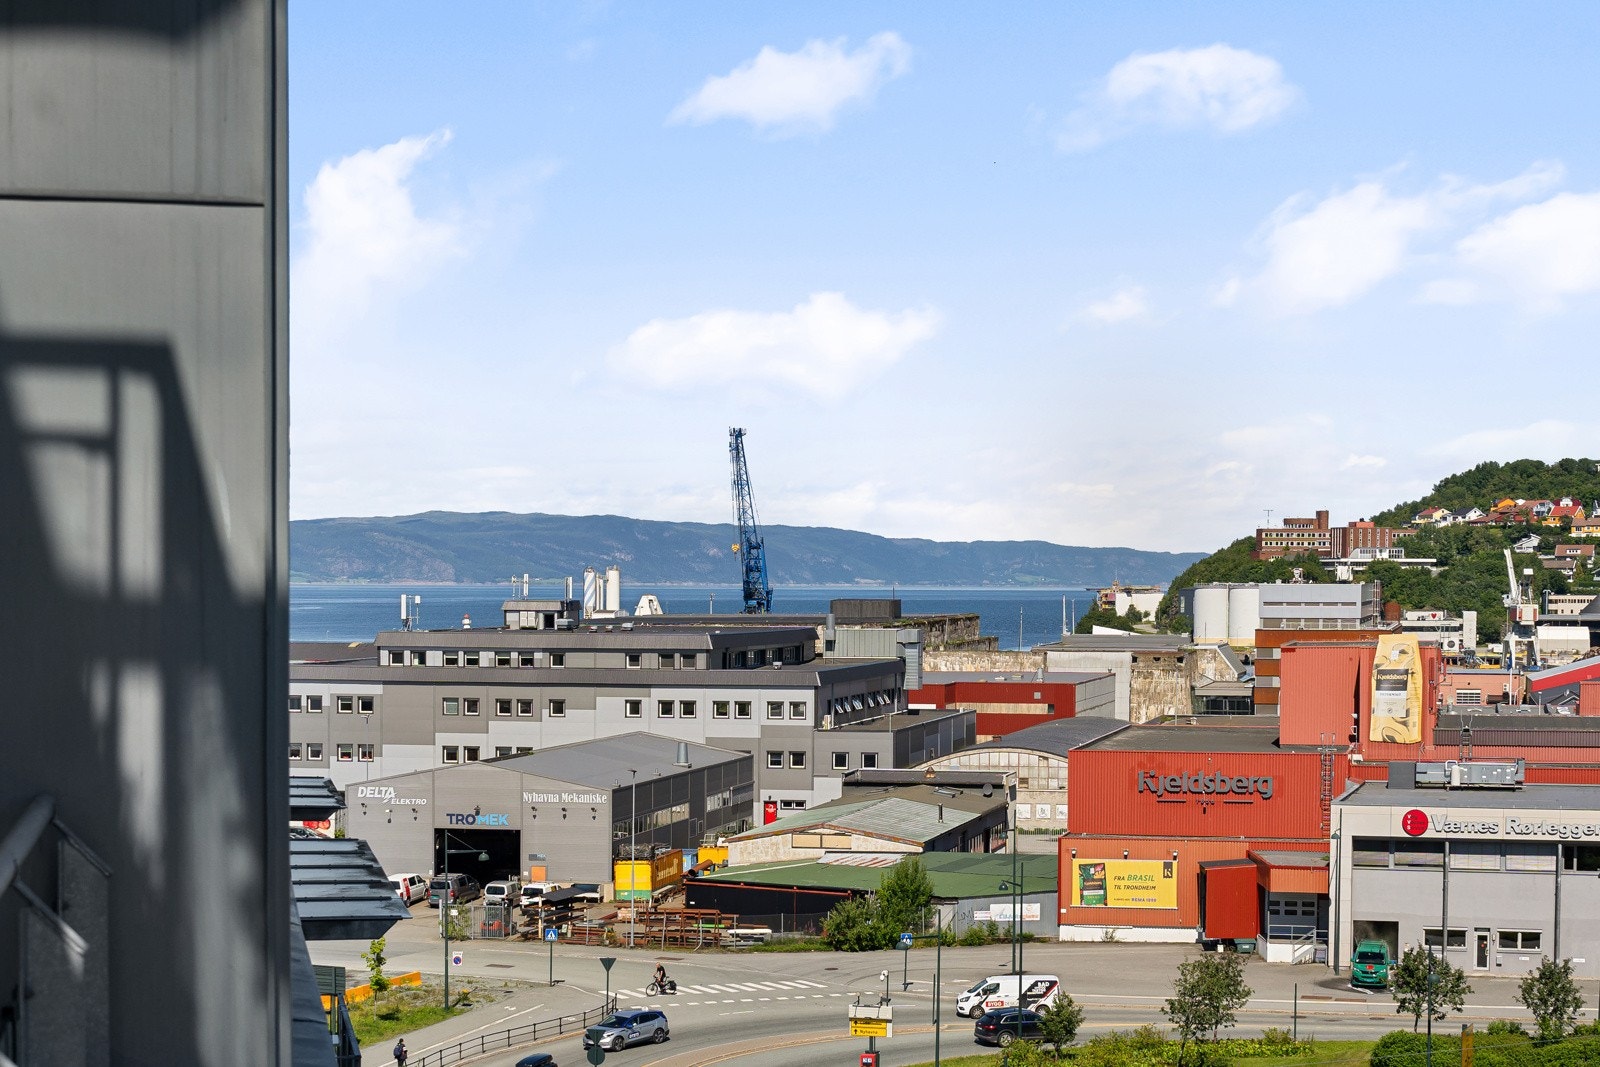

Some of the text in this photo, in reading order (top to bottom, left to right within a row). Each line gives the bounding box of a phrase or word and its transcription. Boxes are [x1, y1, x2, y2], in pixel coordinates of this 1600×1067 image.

[1137, 770, 1274, 799] Kjeldsberg
[357, 786, 396, 799] DELTA
[522, 791, 607, 804] Nyhavna Mekaniske
[446, 813, 509, 826] TROMEK
[1430, 814, 1499, 834] Værnes
[1126, 874, 1155, 882] BRASIL
